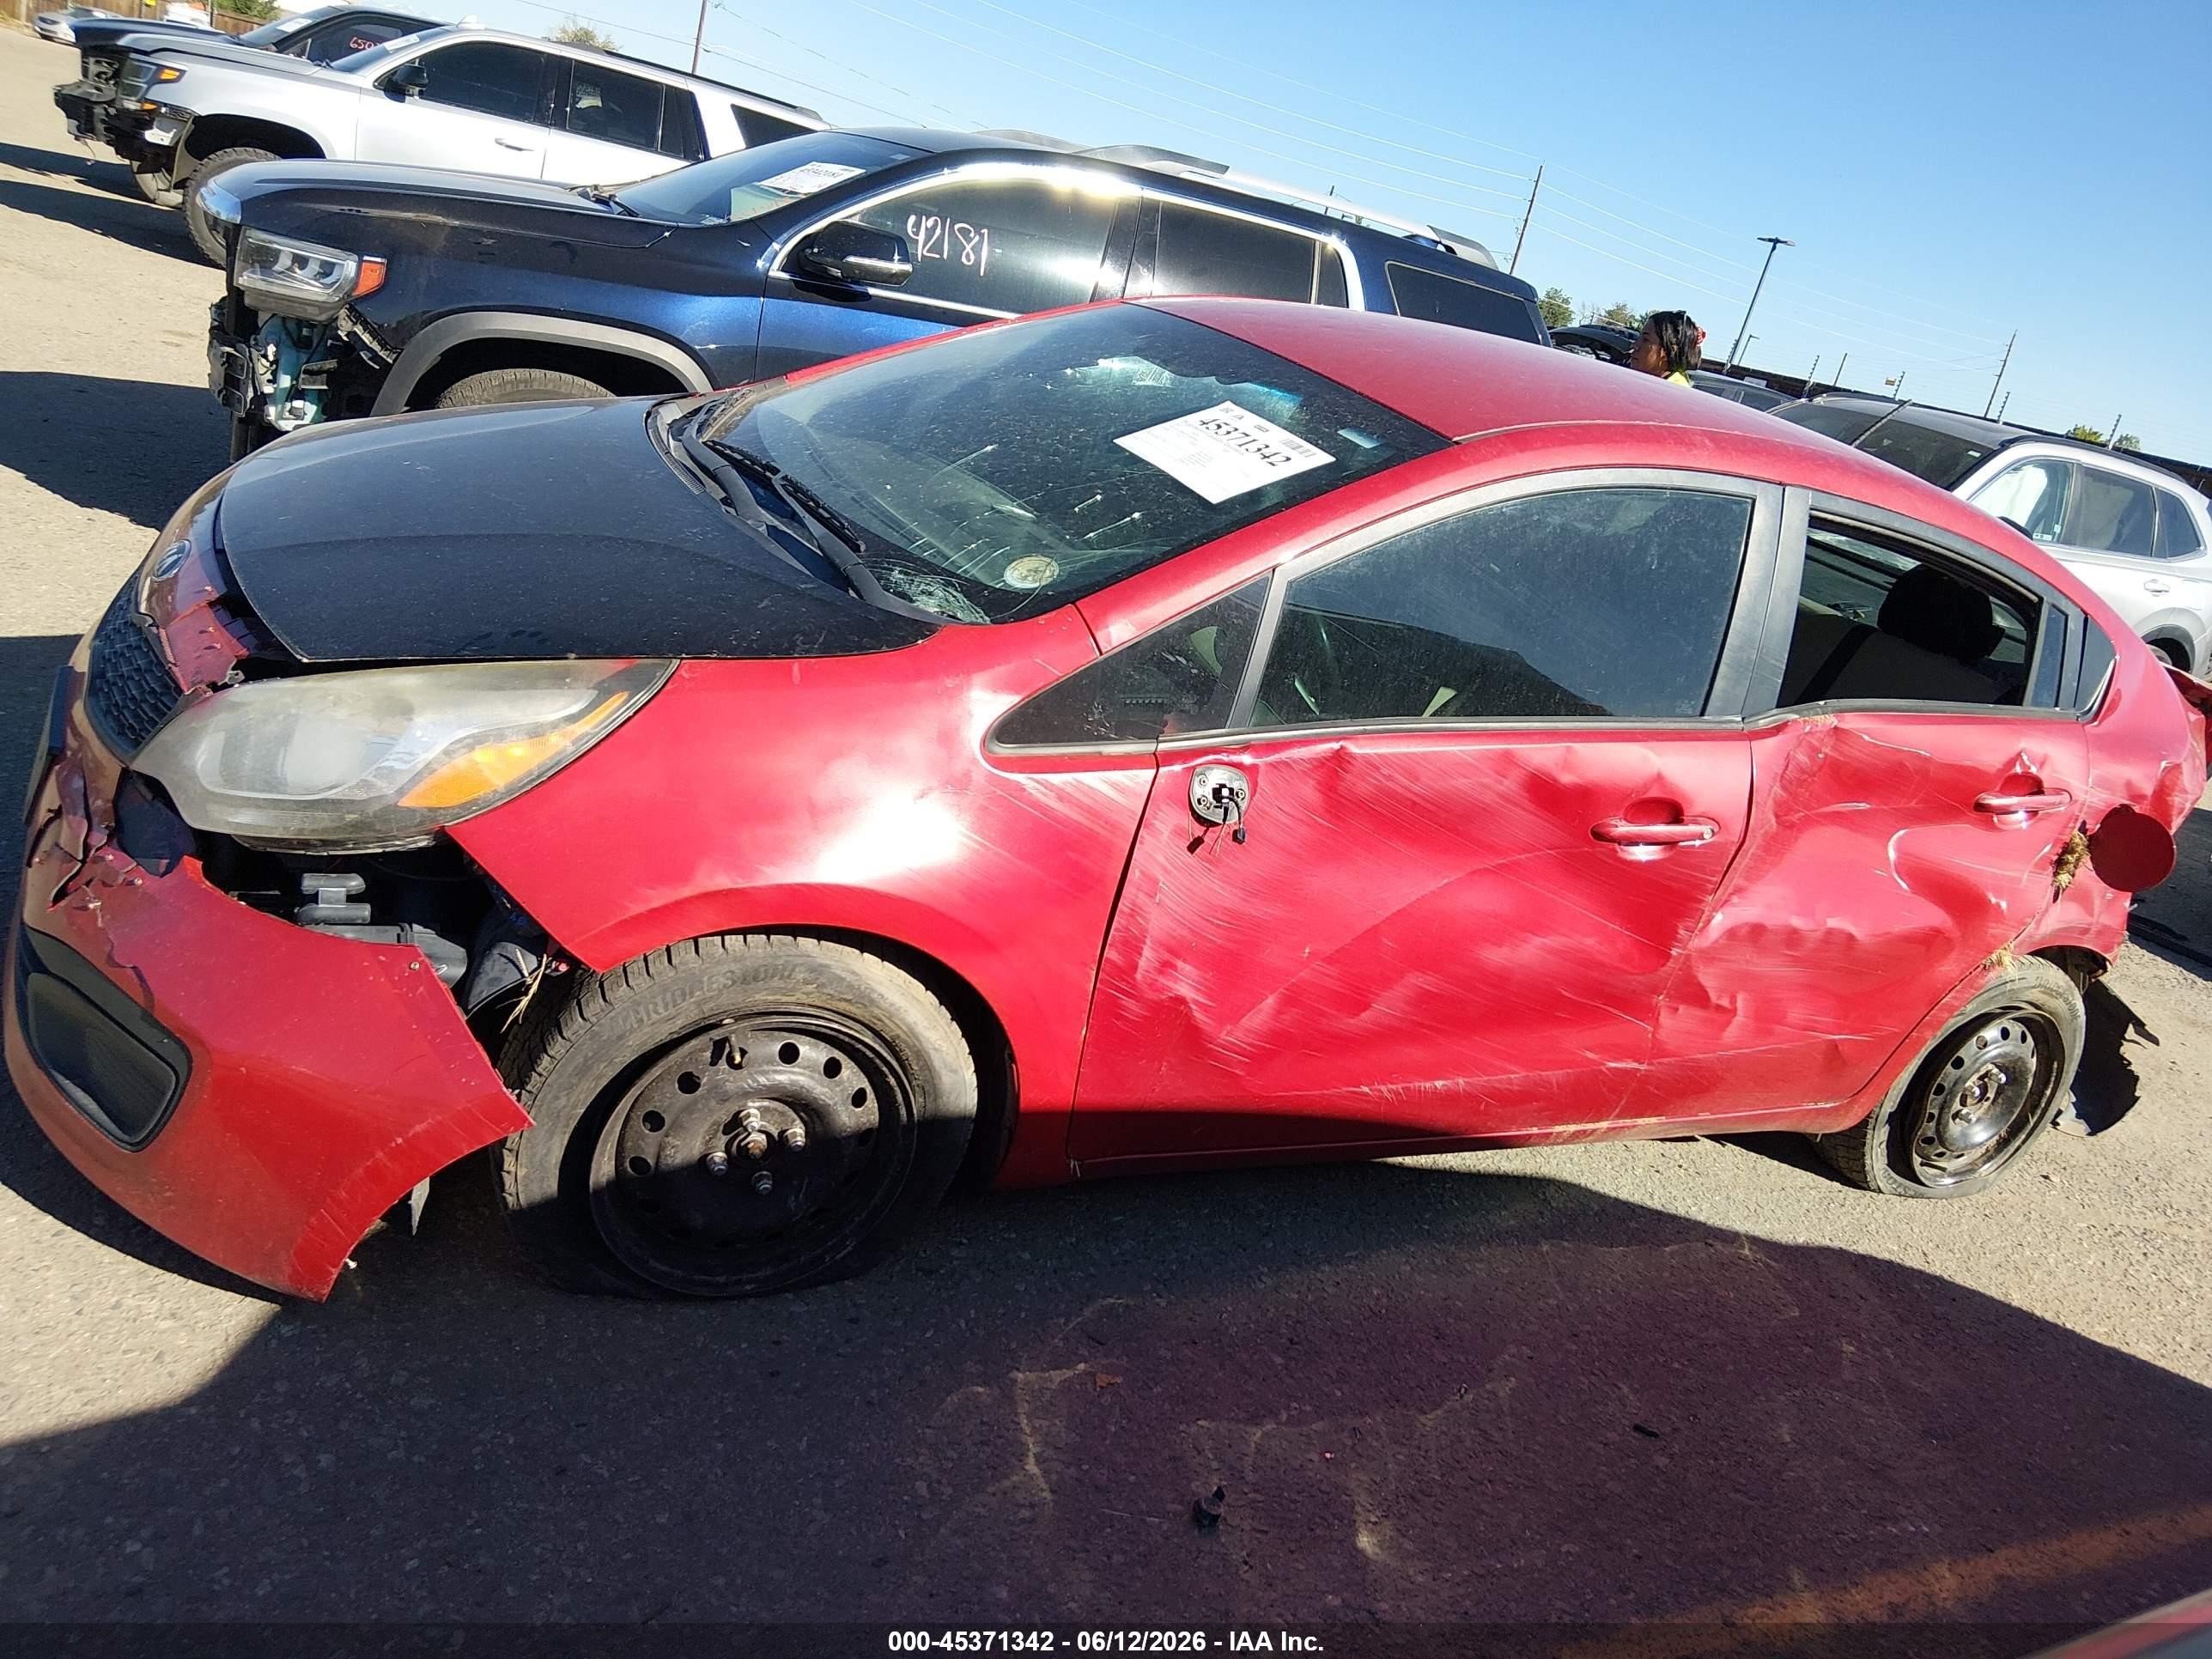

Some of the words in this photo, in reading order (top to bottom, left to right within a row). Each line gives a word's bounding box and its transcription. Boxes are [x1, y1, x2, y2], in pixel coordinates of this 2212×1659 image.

[349, 36, 380, 50] 650
[907, 214, 988, 276] 42181
[1198, 417, 1292, 467] 45371342
